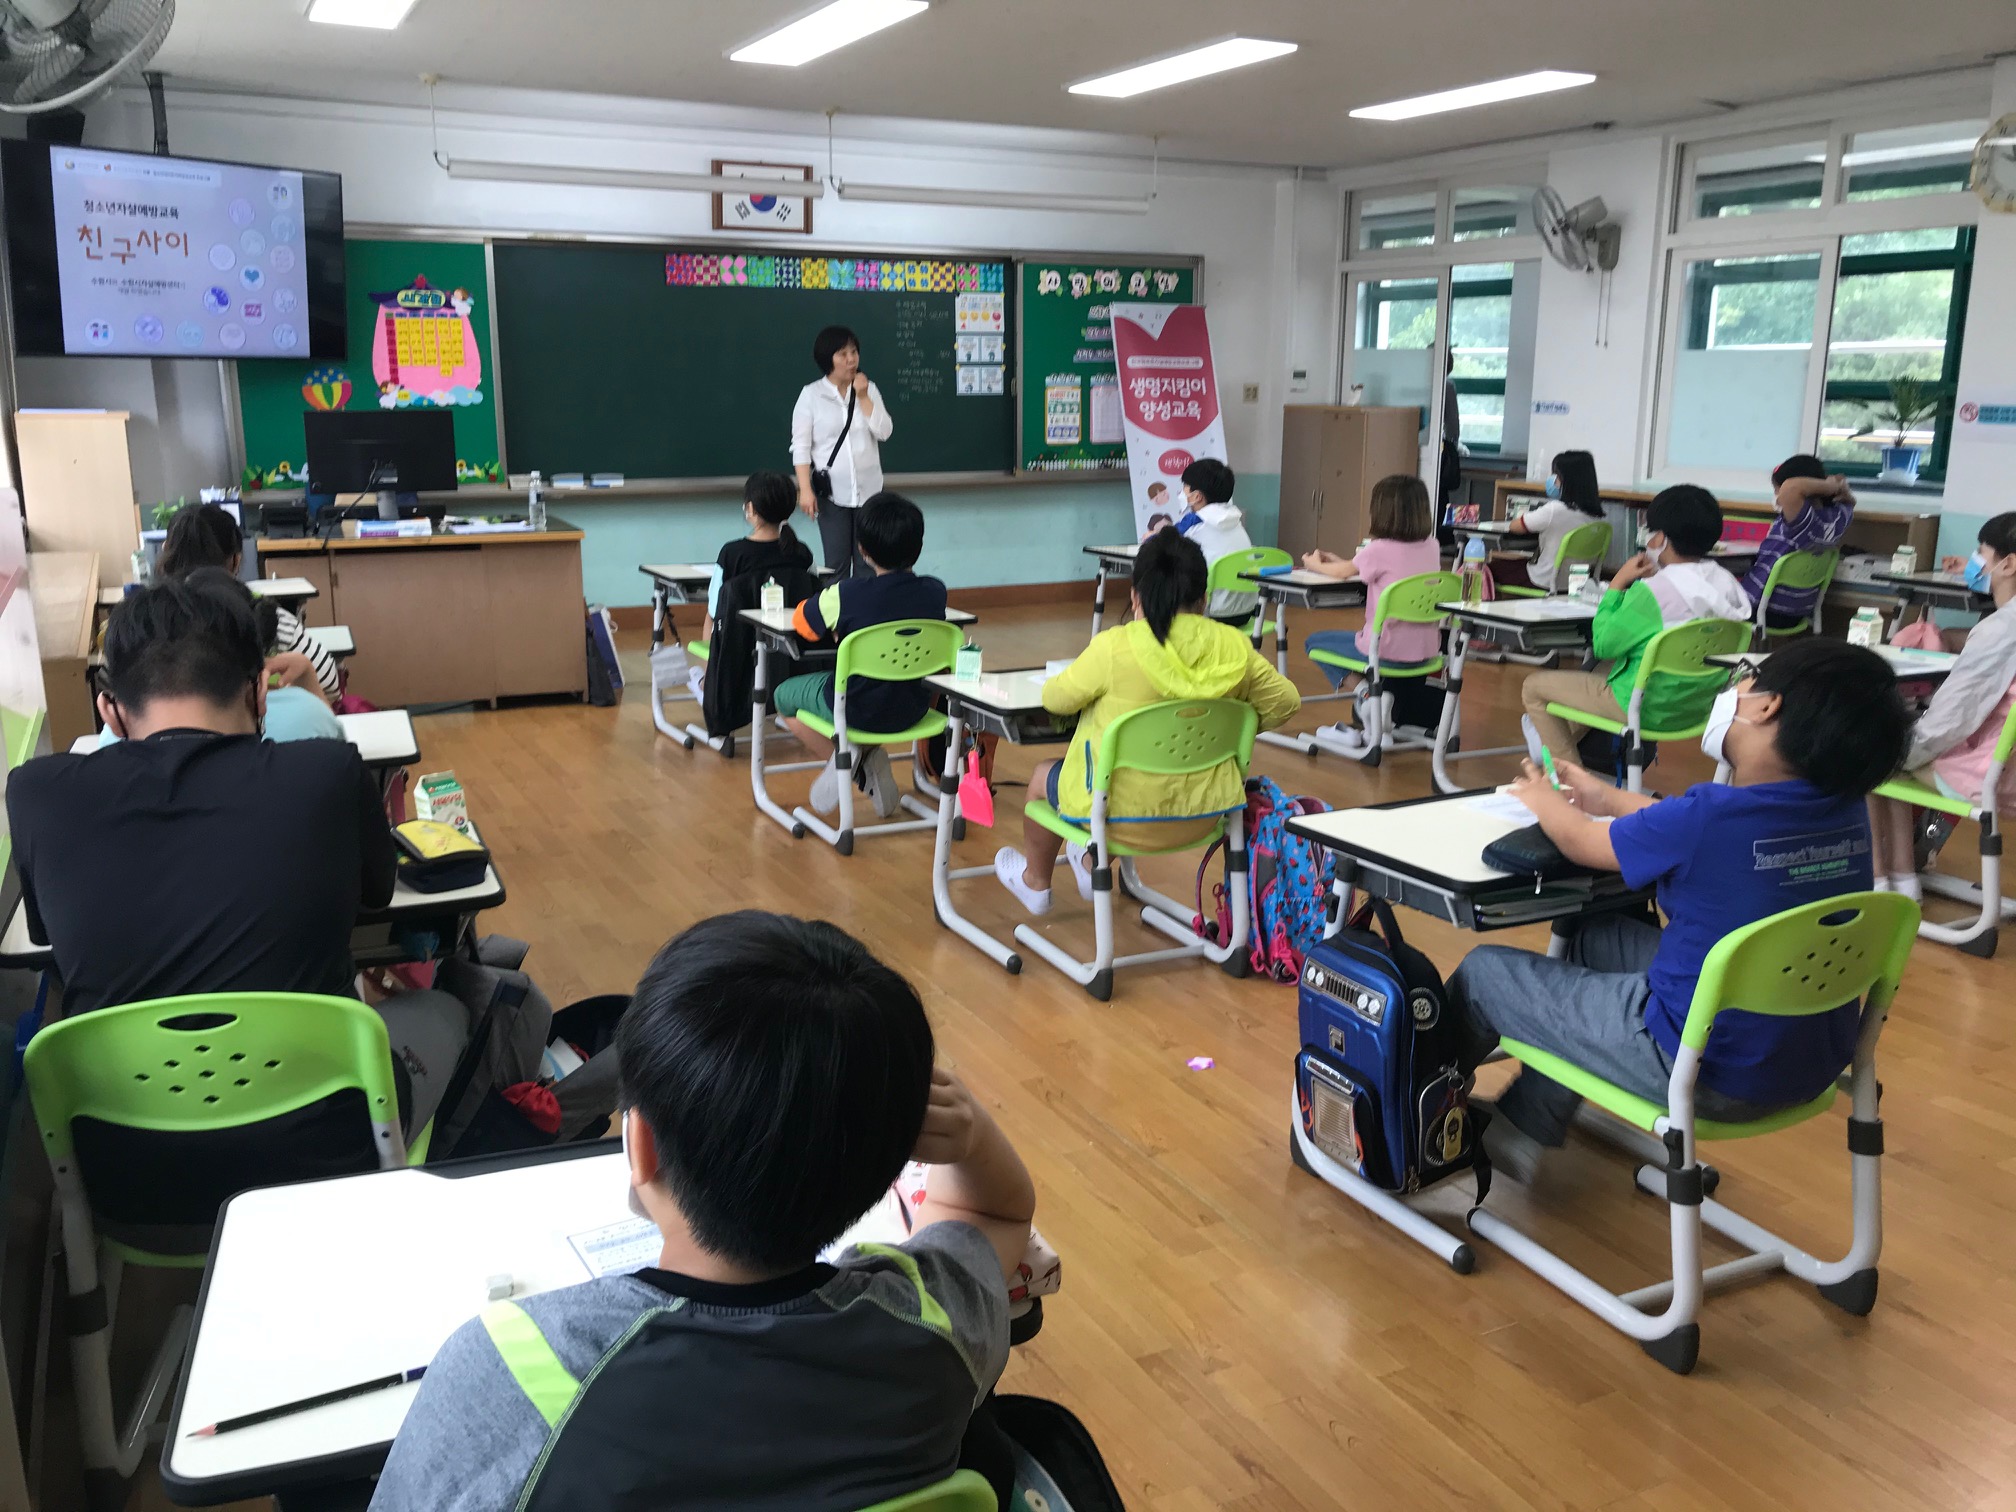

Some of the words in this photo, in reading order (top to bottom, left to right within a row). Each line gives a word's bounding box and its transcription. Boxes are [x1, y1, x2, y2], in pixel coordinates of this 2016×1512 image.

[84, 200, 179, 219] 청소년자살예방교육
[77, 224, 188, 265] 친구사이
[1129, 376, 1207, 399] 생명지킴이
[1139, 400, 1202, 422] 양성교육
